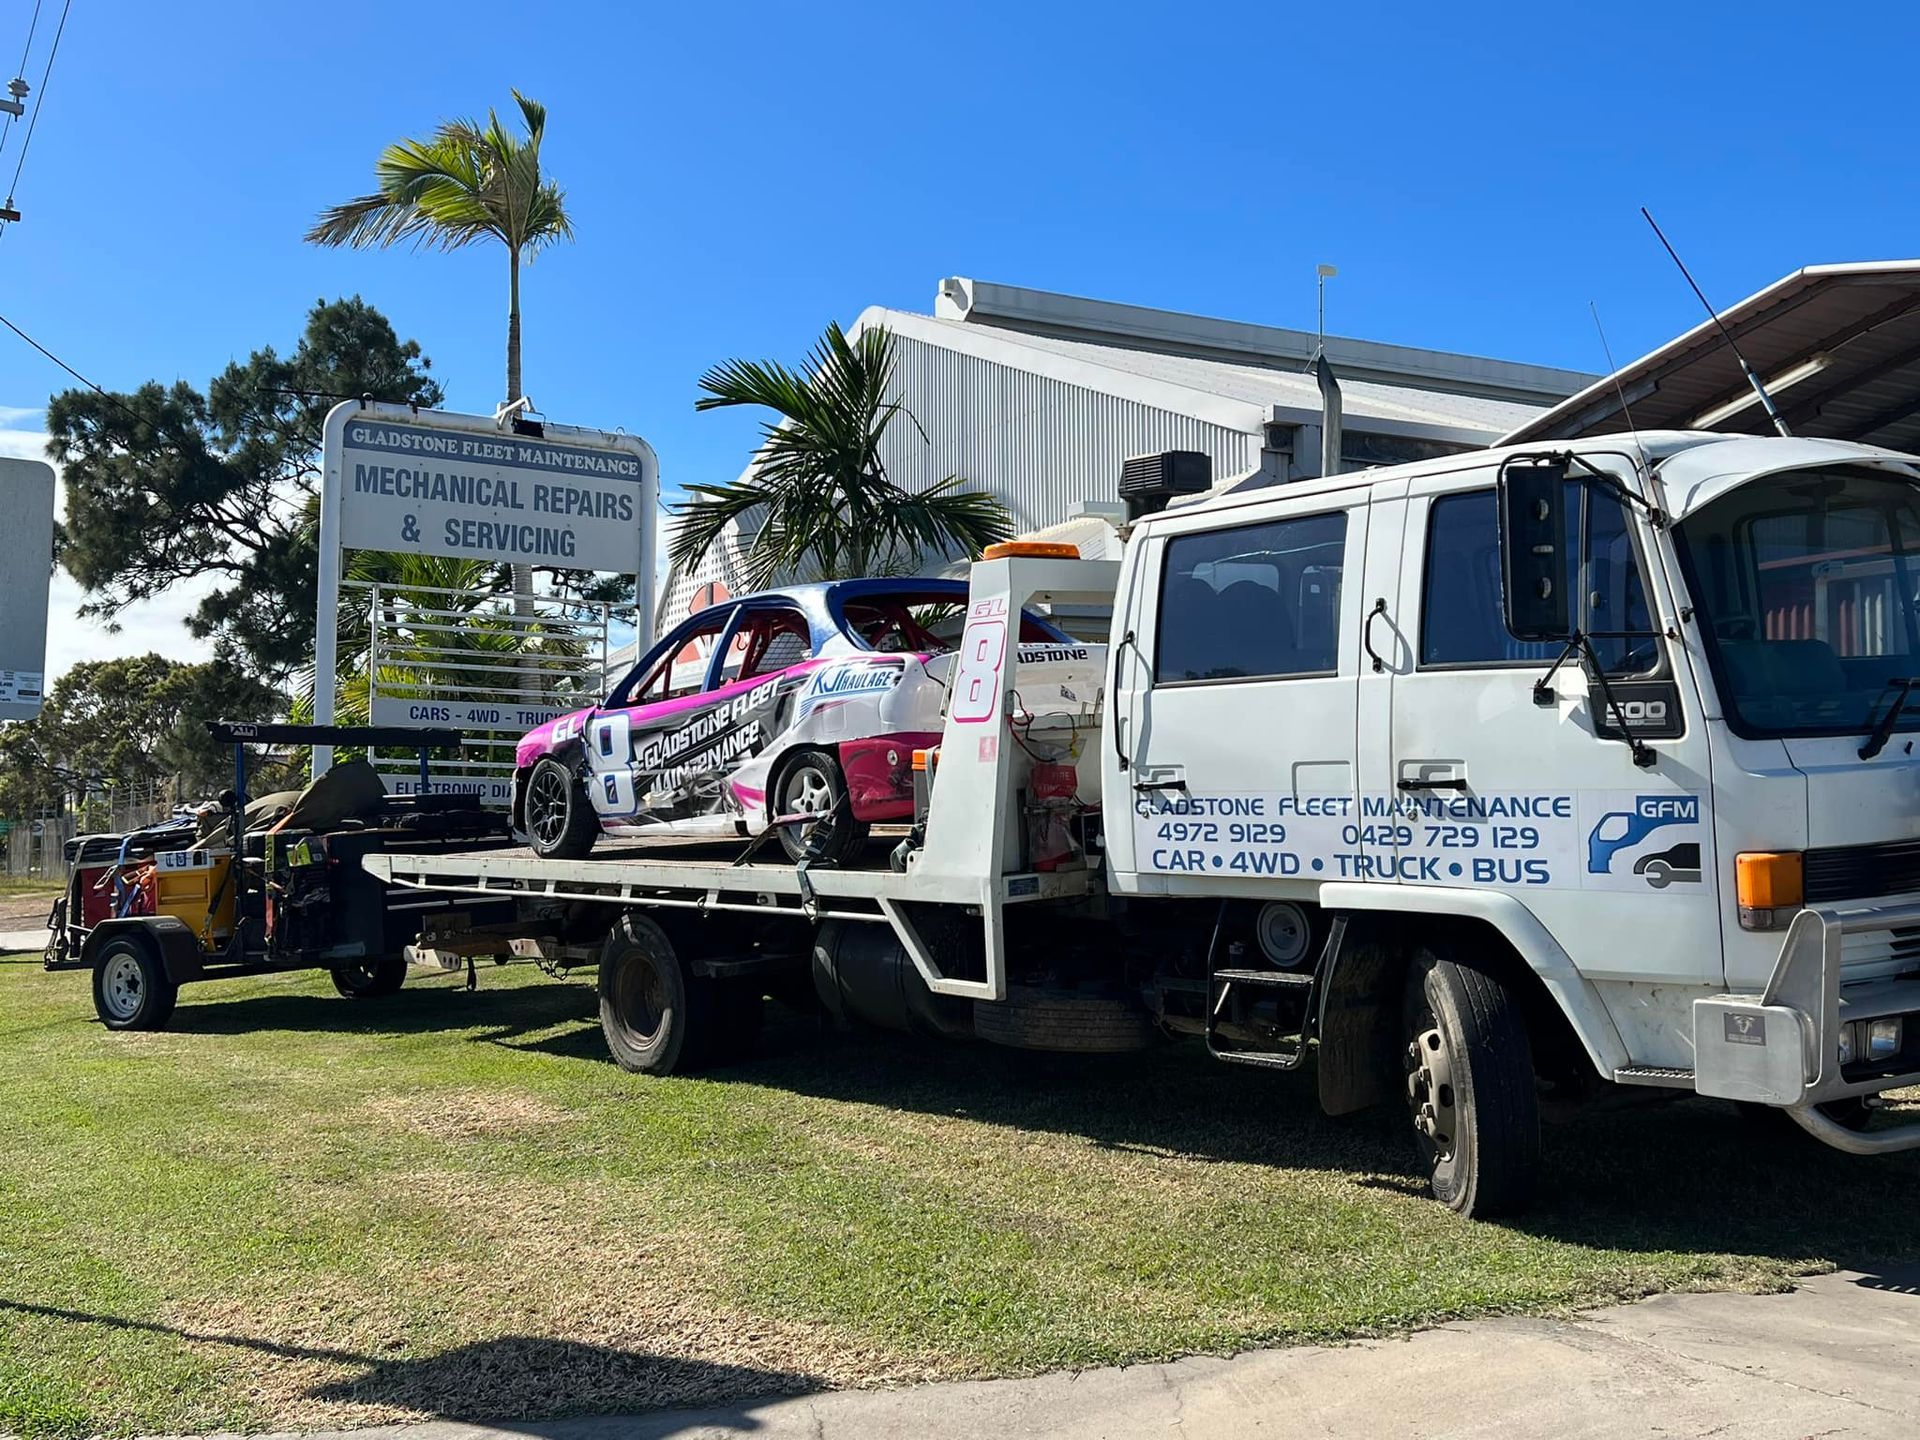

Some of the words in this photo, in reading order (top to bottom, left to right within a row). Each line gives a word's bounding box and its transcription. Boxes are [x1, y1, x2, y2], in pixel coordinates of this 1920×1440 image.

[352, 427, 458, 455] GLADSTONE
[462, 441, 515, 461] FLEET
[518, 448, 639, 476] MAINTENANCE
[355, 463, 524, 510] MECHANICAL
[534, 484, 633, 521] REPAIRS
[401, 514, 420, 543] &
[445, 518, 576, 557] SERVICING
[969, 598, 1007, 619] GL
[839, 671, 893, 690] HAULAGE
[953, 620, 1006, 724] 8
[409, 705, 450, 721] CARS
[467, 709, 500, 723] 4WD
[516, 711, 567, 725] TRUC
[644, 704, 730, 771] GLADSTONE
[731, 675, 785, 720] FLEET
[552, 716, 579, 744] GL
[1135, 798, 1264, 816] GLADSTONE
[1279, 797, 1352, 816] FLEET
[1363, 796, 1571, 818] MAINTENANCE
[1640, 801, 1696, 818] GFM
[1157, 822, 1218, 842] 4972
[1229, 823, 1286, 843] 9129
[1342, 825, 1413, 846] 0429
[1424, 826, 1480, 848] 729
[1492, 826, 1540, 849] 129
[1152, 850, 1206, 871] CAR
[1229, 852, 1300, 874] 4WD
[1333, 854, 1441, 880] TRUCK
[1472, 858, 1550, 884] BUS
